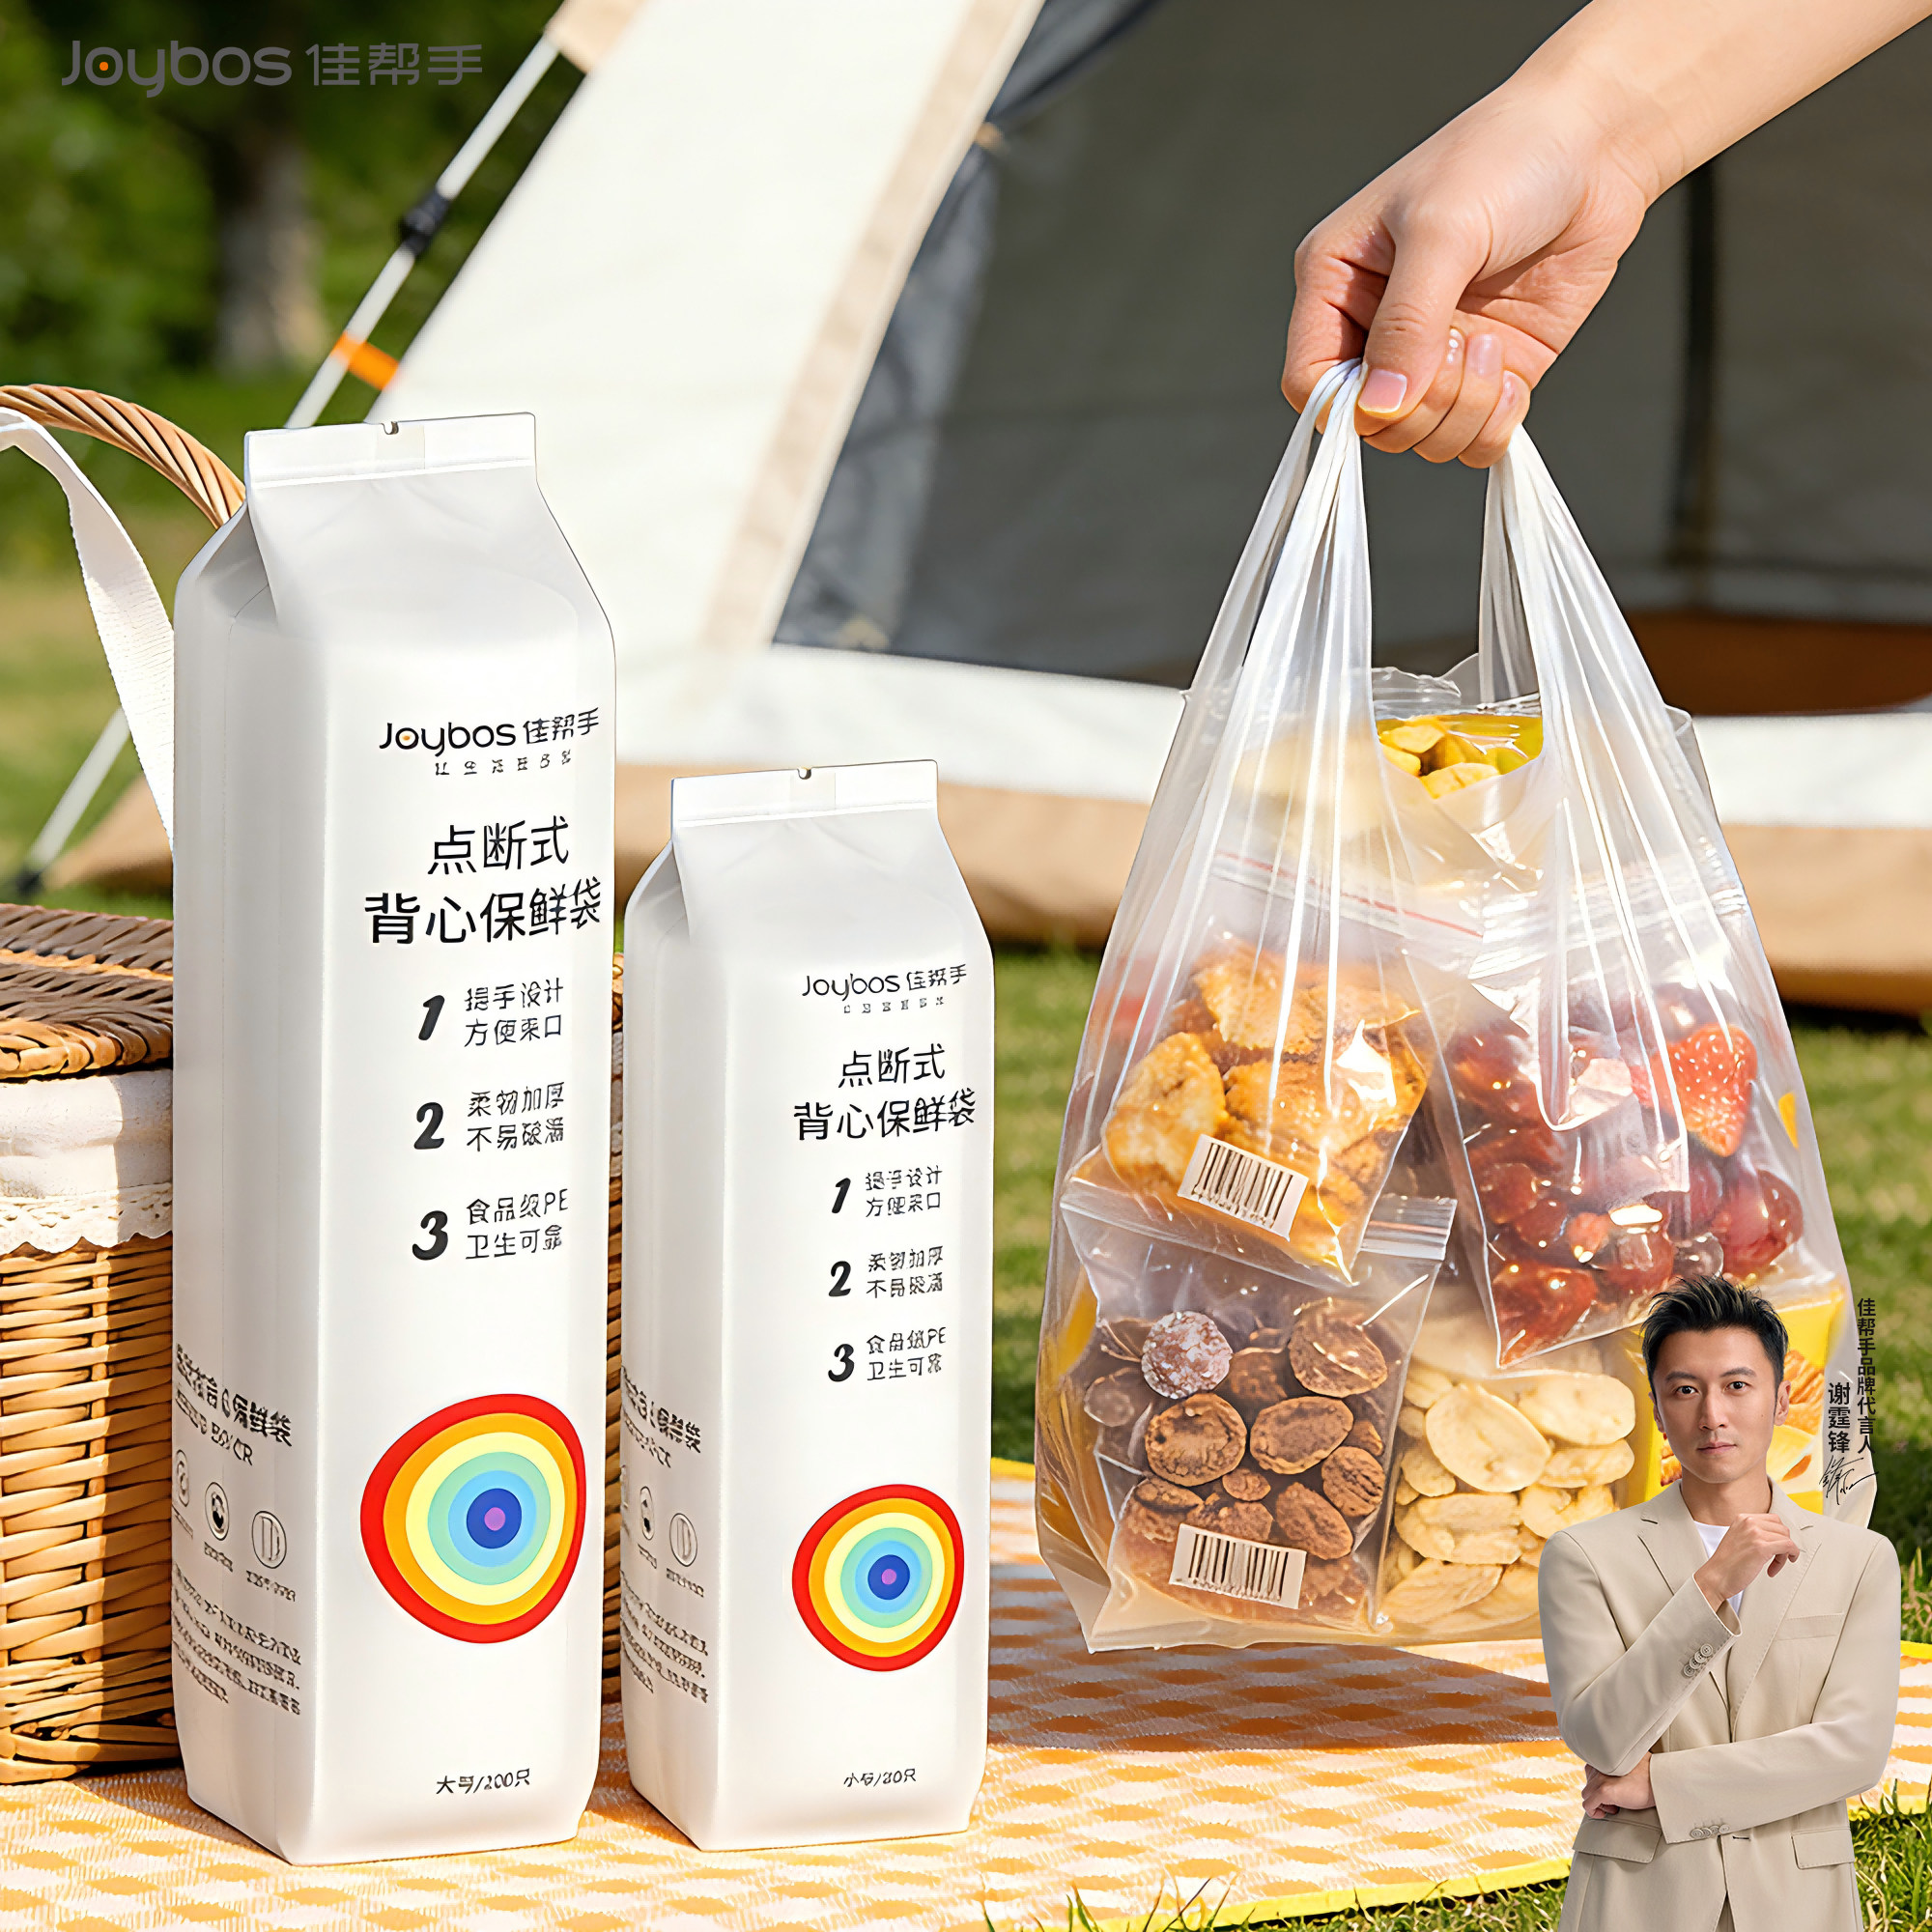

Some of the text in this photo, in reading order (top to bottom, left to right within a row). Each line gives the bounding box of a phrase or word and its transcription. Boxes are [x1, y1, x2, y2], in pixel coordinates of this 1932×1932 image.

[379, 722, 517, 757] Joybos
[427, 815, 569, 875] 点断式
[364, 875, 601, 945] 背心保鲜袋
[802, 973, 900, 1001] Joybos
[418, 994, 445, 1041] 1
[838, 1043, 946, 1089] 点断式
[413, 1101, 445, 1151] 2
[793, 1087, 976, 1141] 背心保鲜袋
[831, 1178, 851, 1214] 1
[412, 1209, 449, 1262] 3
[828, 1261, 851, 1297] 2
[827, 1344, 855, 1382] 3
